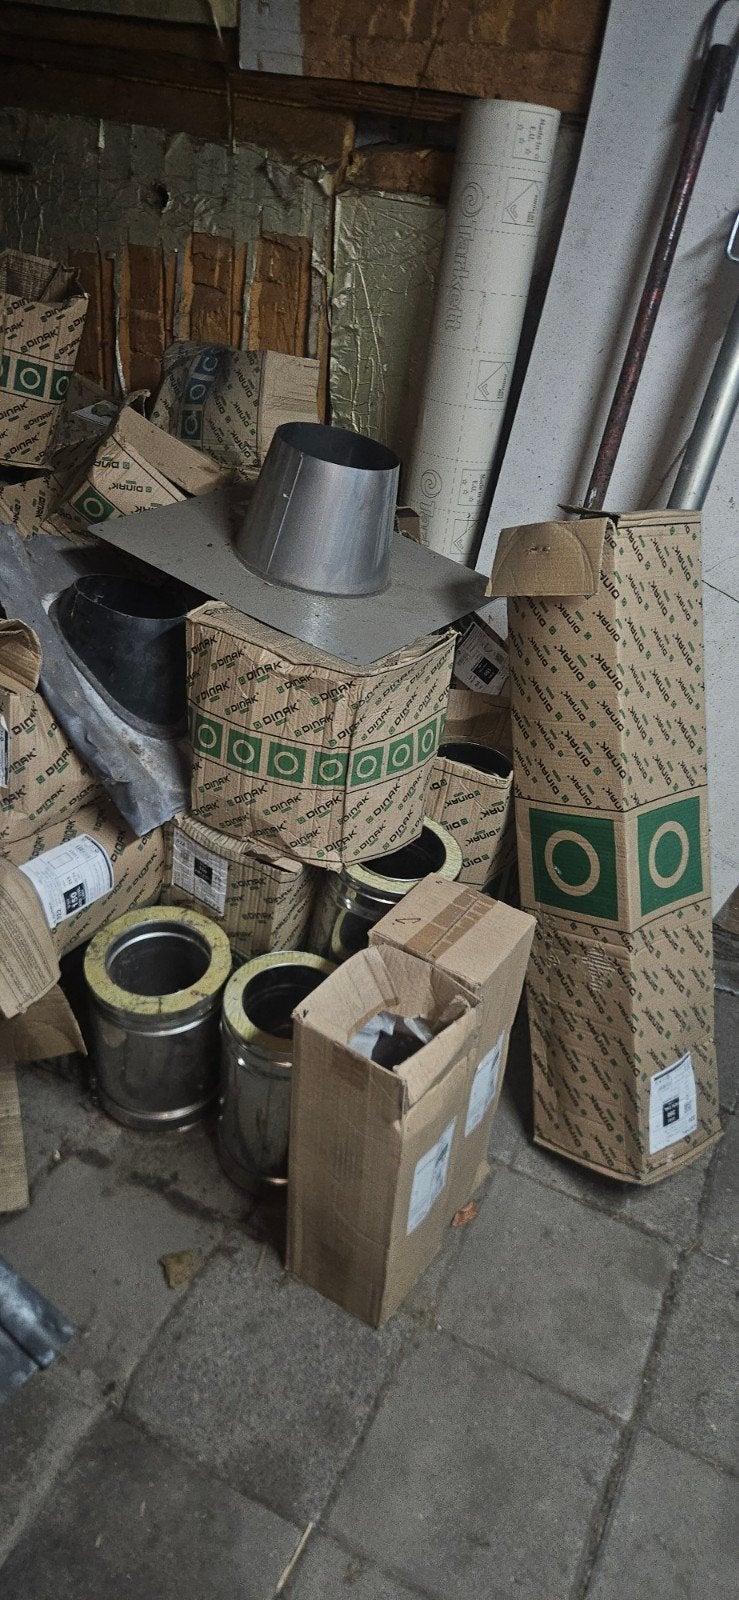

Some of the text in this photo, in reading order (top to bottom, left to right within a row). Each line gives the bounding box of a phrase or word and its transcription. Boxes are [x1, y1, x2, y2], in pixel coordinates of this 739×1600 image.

[444, 219, 475, 332] Tarkett
[27, 329, 59, 348] DINAK
[28, 410, 53, 425] DINAK
[10, 435, 39, 454] DINAK
[675, 545, 691, 581] DINAK
[628, 573, 642, 604] DINAK
[651, 581, 667, 616] DINAK
[558, 604, 580, 634] DINAK
[676, 592, 691, 621] DINAK
[597, 610, 620, 642] DINAK
[627, 616, 644, 652] DINAK
[217, 649, 244, 667] DINAK
[530, 637, 548, 667] DINAK
[558, 645, 584, 681] DINAK
[675, 632, 693, 666] DINAK
[246, 661, 282, 681] DINAK
[595, 653, 623, 691] DINAK
[652, 669, 669, 702] DINAK
[201, 681, 230, 700] DINAK
[231, 695, 258, 712] DINAK
[319, 680, 356, 701] DINAK
[419, 683, 437, 712] DINAK
[531, 677, 553, 712] DINAK
[677, 678, 693, 705] DINAK
[262, 702, 299, 725] DINAK
[367, 705, 392, 734] DINAK
[394, 691, 417, 726] DINAK
[563, 691, 586, 721] DINAK
[601, 700, 624, 732] DINAK
[302, 714, 333, 733] DINAK
[537, 720, 555, 750] DINAK
[630, 706, 647, 740] DINAK
[677, 717, 695, 749] DINAK
[9, 751, 37, 773] INAK
[565, 730, 590, 767] DINAK
[601, 741, 626, 779] DINAK
[204, 776, 230, 790] DINAK
[538, 759, 559, 795] DINAK
[655, 754, 671, 786] DINAK
[234, 785, 267, 803] DINAK
[270, 795, 302, 812] DINAK
[373, 783, 401, 816] DINAK
[402, 774, 422, 803] DINAK
[570, 775, 592, 806] DINAK
[306, 795, 342, 819] DINAK
[343, 796, 369, 822] DINAK
[480, 806, 505, 818] NAK
[289, 829, 320, 848] DINAK
[360, 824, 387, 850] DINAK
[389, 809, 414, 842] DINAK
[325, 830, 357, 852] DINAK
